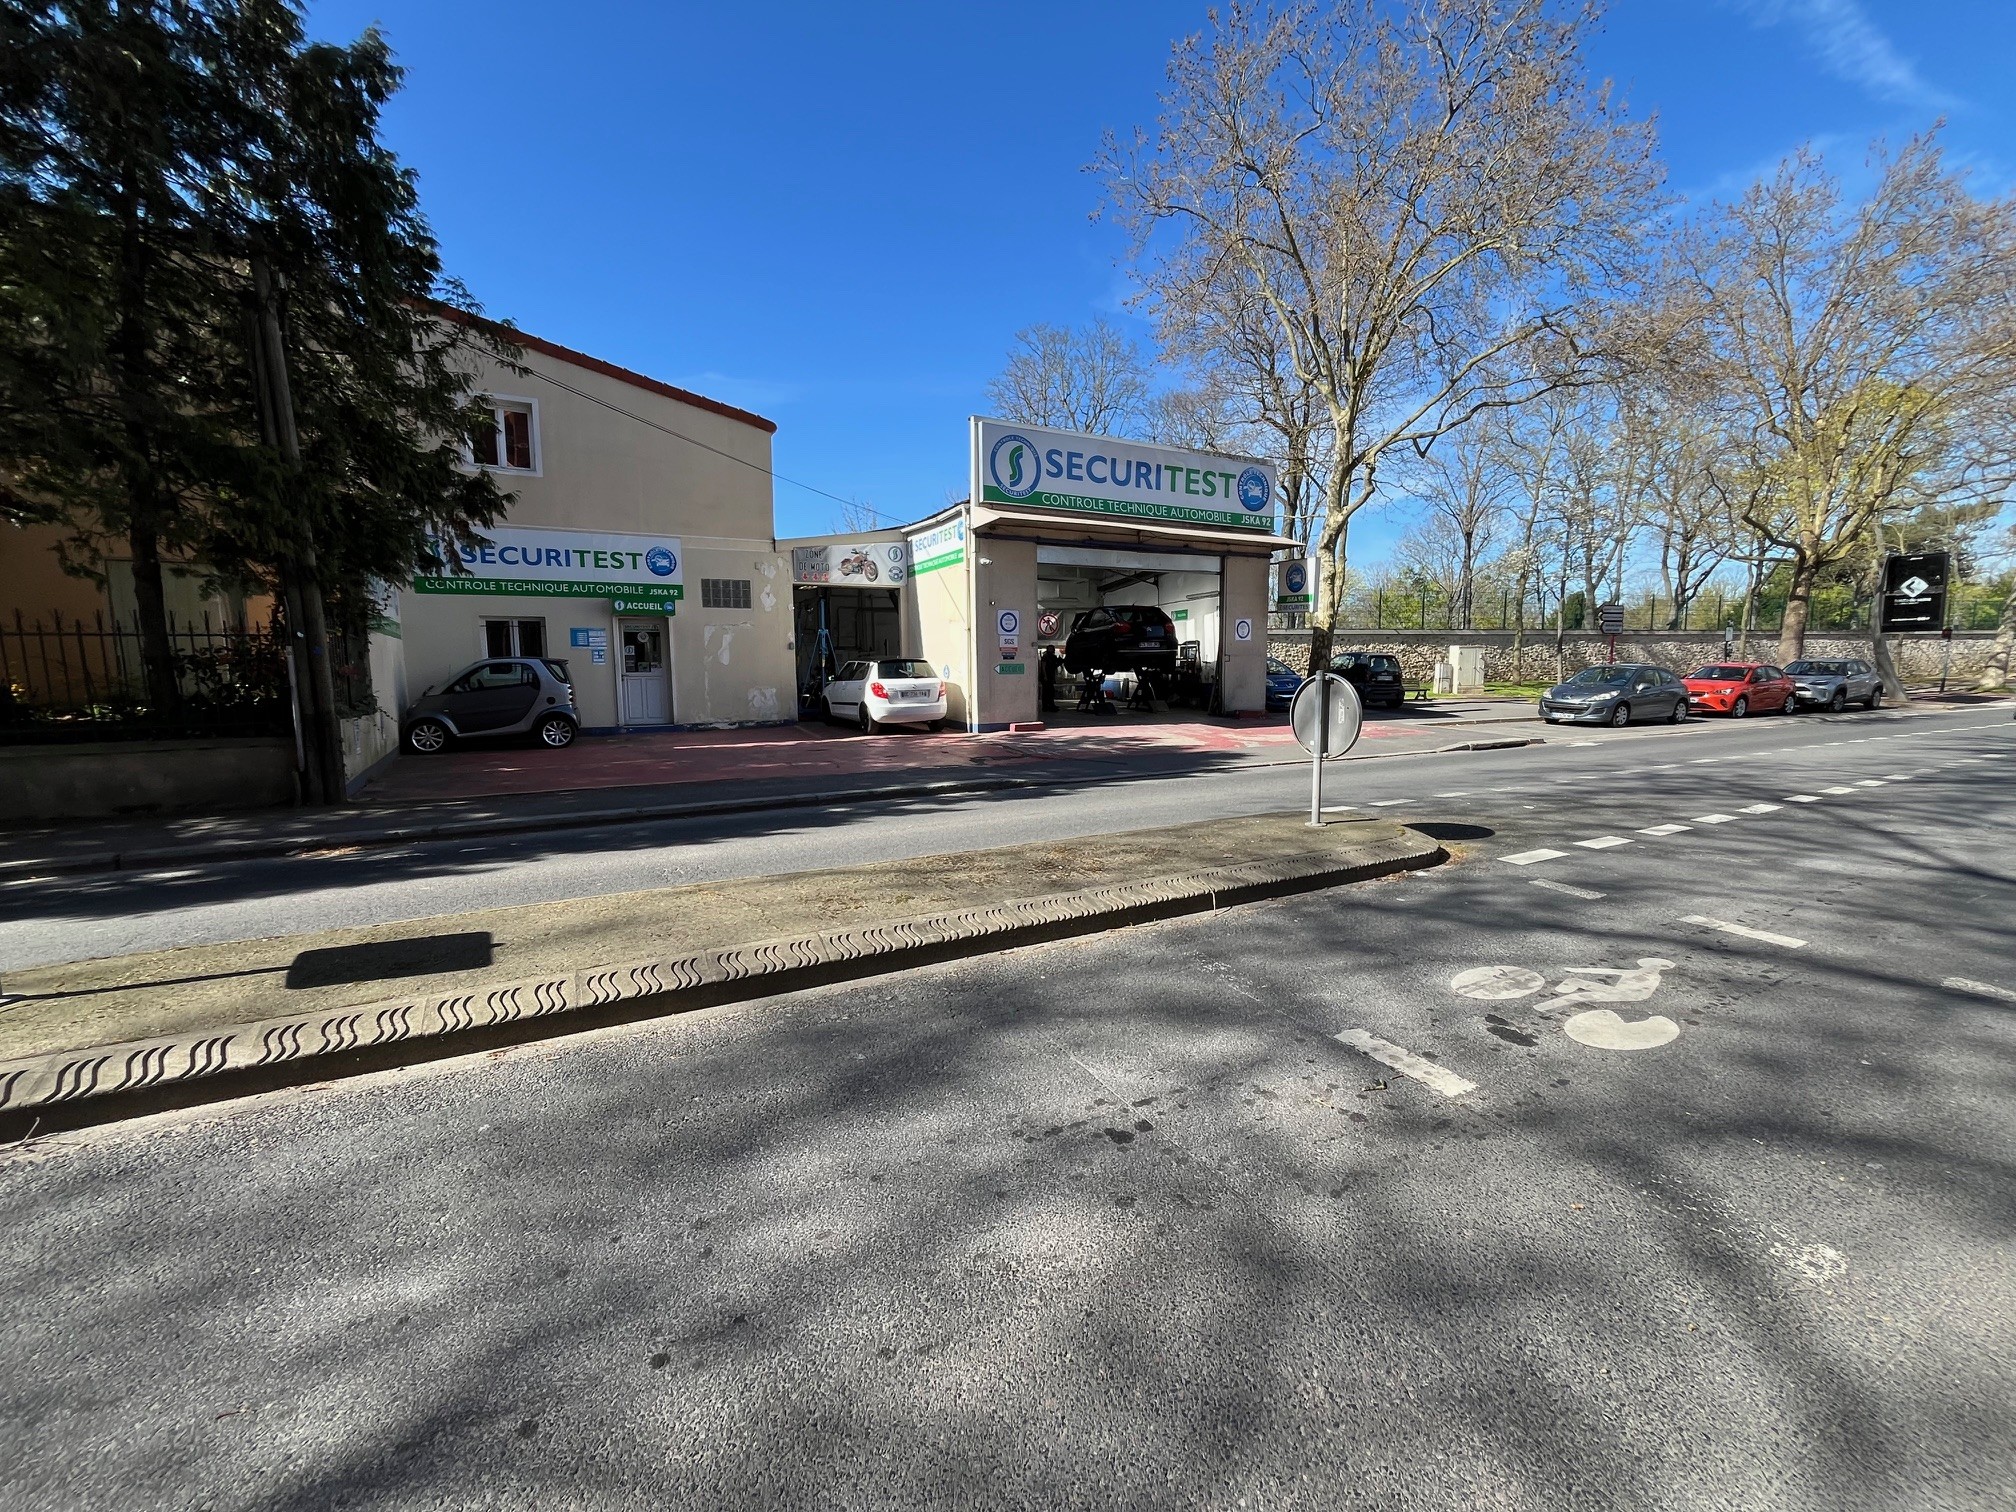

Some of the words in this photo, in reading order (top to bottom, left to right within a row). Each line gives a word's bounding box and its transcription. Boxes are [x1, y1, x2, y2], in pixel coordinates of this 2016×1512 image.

[1045, 448, 1237, 499] SECURITEST
[1000, 483, 1031, 496] SECURITEST
[1041, 493, 1105, 510] CONTROLE
[1107, 500, 1167, 517] TECHNIQUE
[1170, 506, 1232, 523] AUTOMOBILE
[1241, 514, 1261, 526] JSKA
[1262, 516, 1271, 526] 92
[915, 524, 957, 552] SECURITEST
[460, 545, 643, 570] SECURITEST
[805, 549, 823, 559] ZONE
[799, 562, 807, 571] DE
[810, 562, 830, 572] MOTO
[425, 580, 496, 591] CONTROLE
[500, 581, 569, 594] TECHNIQUE
[572, 584, 644, 595] AUTOMOBILE
[649, 588, 668, 596] JSKA
[669, 588, 678, 596] 92
[626, 602, 663, 611] ACCUEIL
